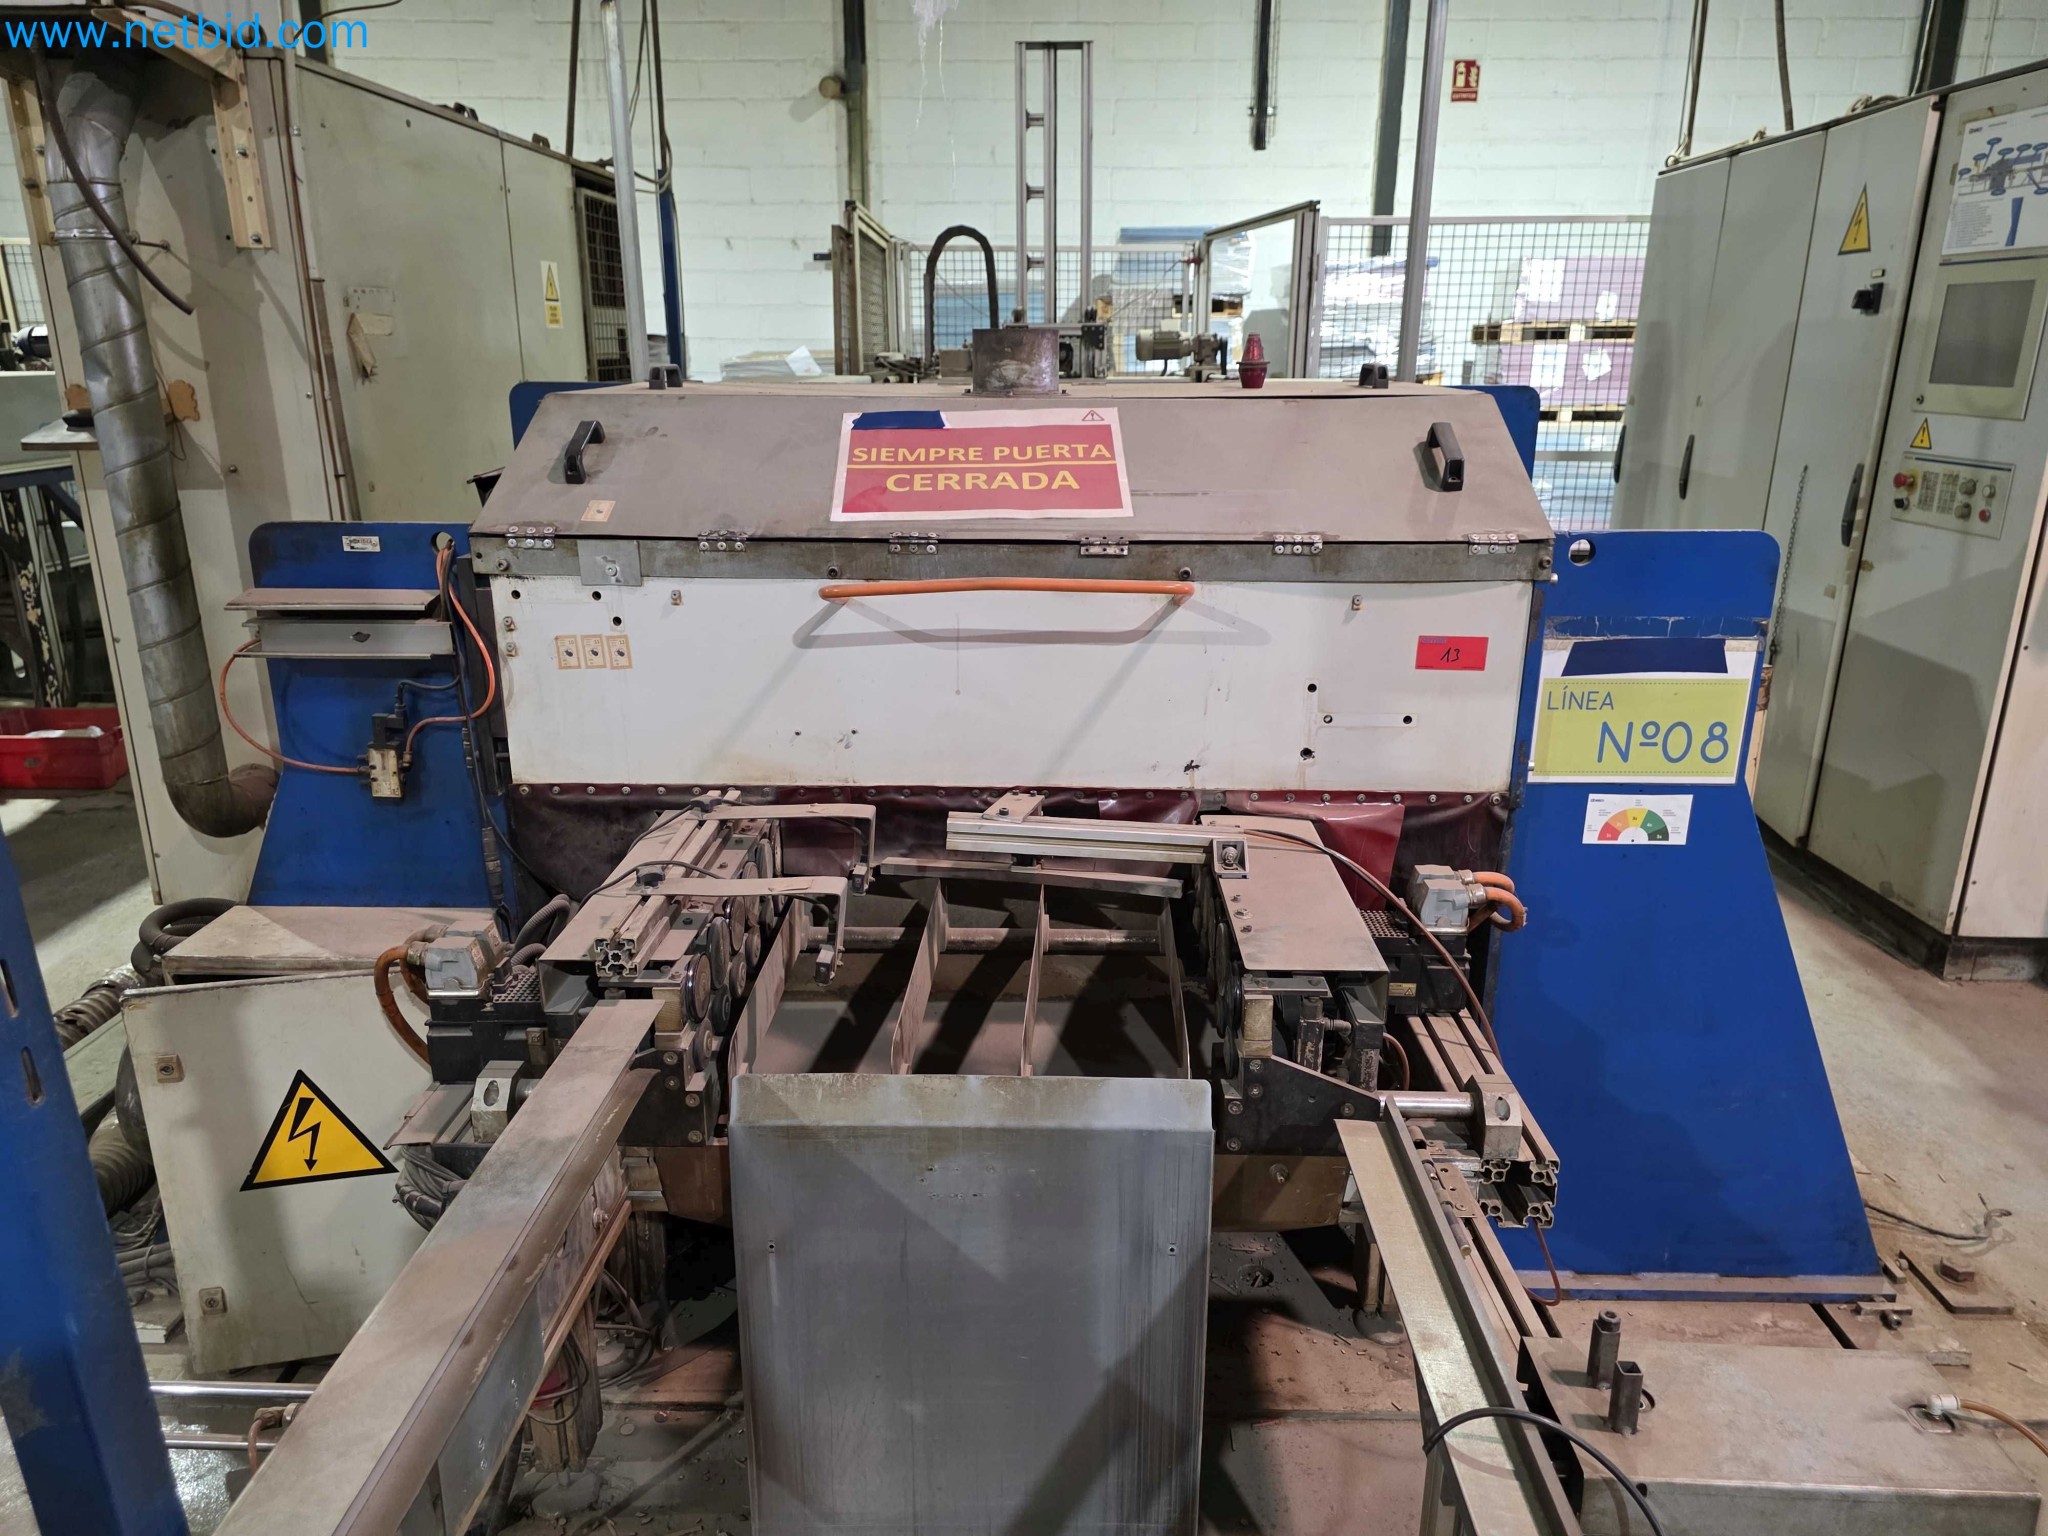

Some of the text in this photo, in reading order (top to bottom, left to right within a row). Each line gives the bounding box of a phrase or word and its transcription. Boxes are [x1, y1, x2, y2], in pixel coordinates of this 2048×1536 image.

[852, 444, 1111, 462] SIEMPRE PUERTA
[886, 470, 1080, 492] CERRADA
[1440, 647, 1460, 663] 13
[1547, 685, 1614, 710] LÍNEA
